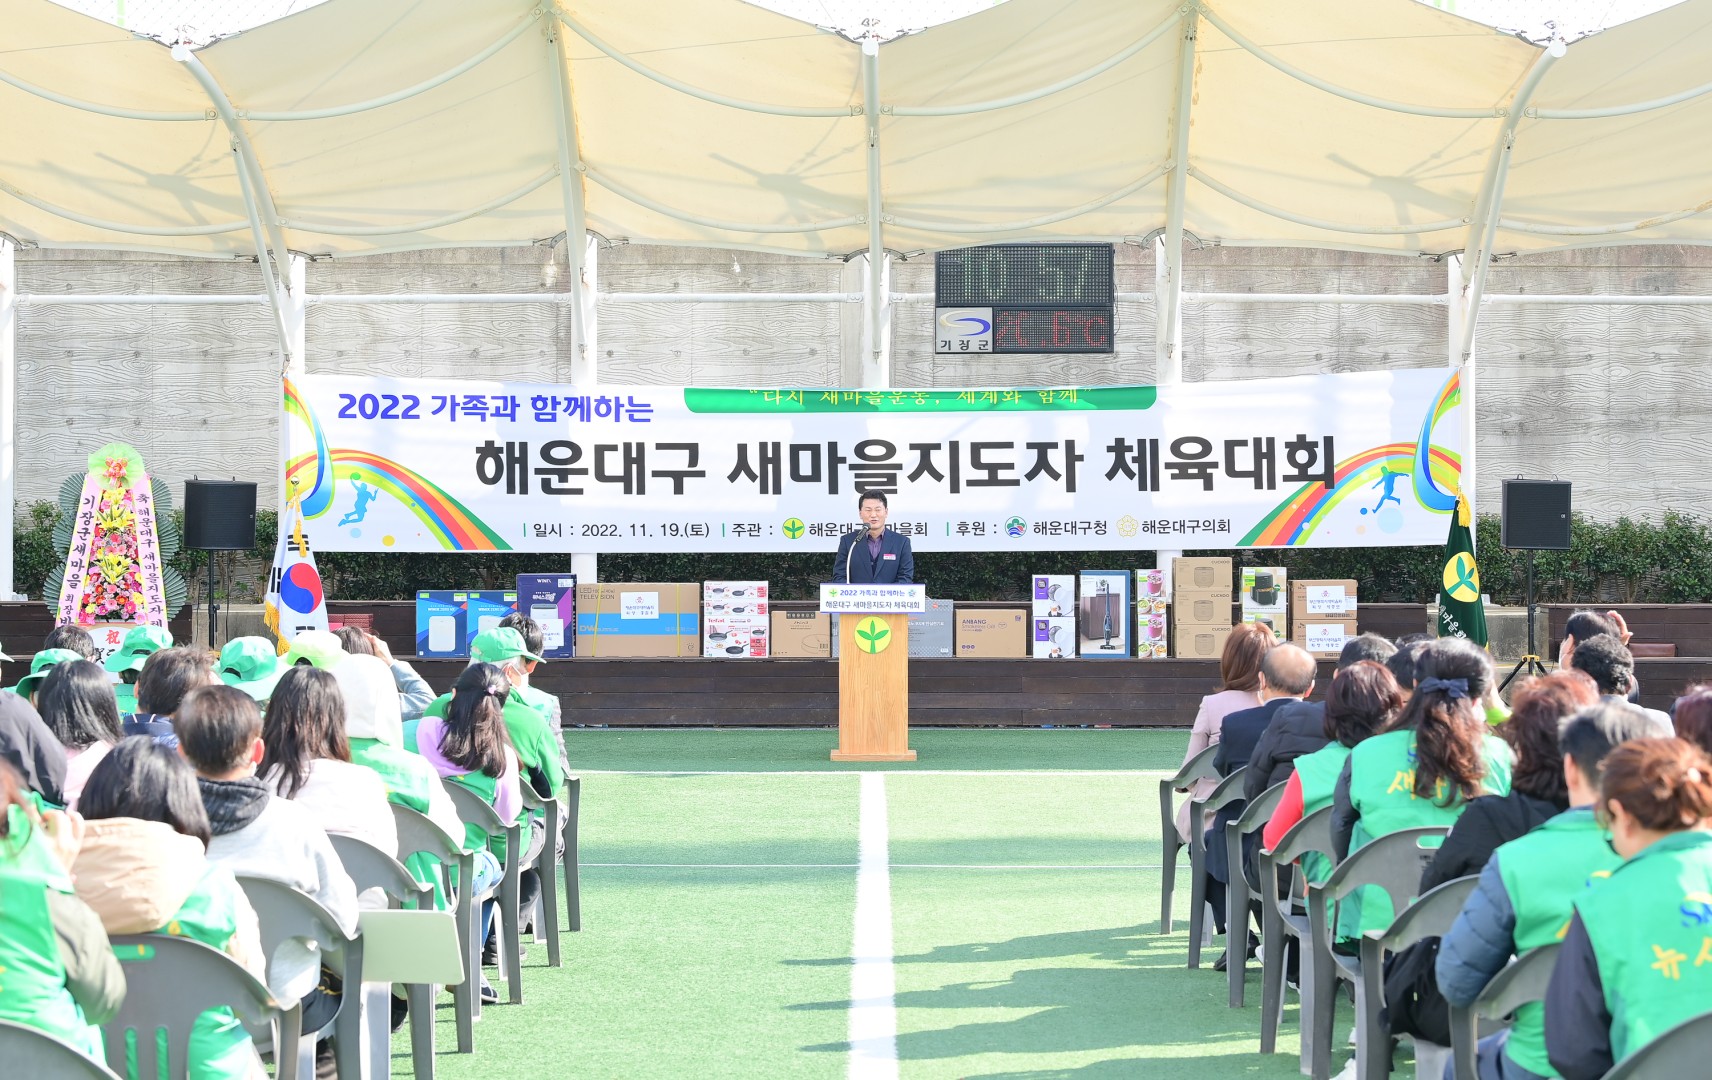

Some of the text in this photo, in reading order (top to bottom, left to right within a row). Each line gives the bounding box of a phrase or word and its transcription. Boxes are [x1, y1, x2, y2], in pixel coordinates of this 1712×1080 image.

[1039, 249, 1092, 300] 57
[940, 339, 990, 352] 기장군
[338, 393, 654, 423] 2022 가족과 함께하는
[476, 433, 1336, 496] 해운대구 새마을지도자 체육대회
[138, 507, 156, 549] 해운대구
[533, 523, 562, 538] 일시
[581, 523, 623, 538] 2022.
[630, 523, 653, 538] 11.
[661, 522, 710, 539] 19.(토)
[731, 523, 762, 538] 주관
[955, 521, 986, 537] 후원
[1033, 520, 1107, 536] 해운대구청
[1141, 518, 1231, 535] 해운대구의회
[142, 551, 164, 615] 새마을지도자
[840, 589, 905, 597] 2022 가족과 함께하는
[825, 600, 920, 609] 해운대구 새마을지도자 체육대회
[105, 629, 121, 645] 祝
